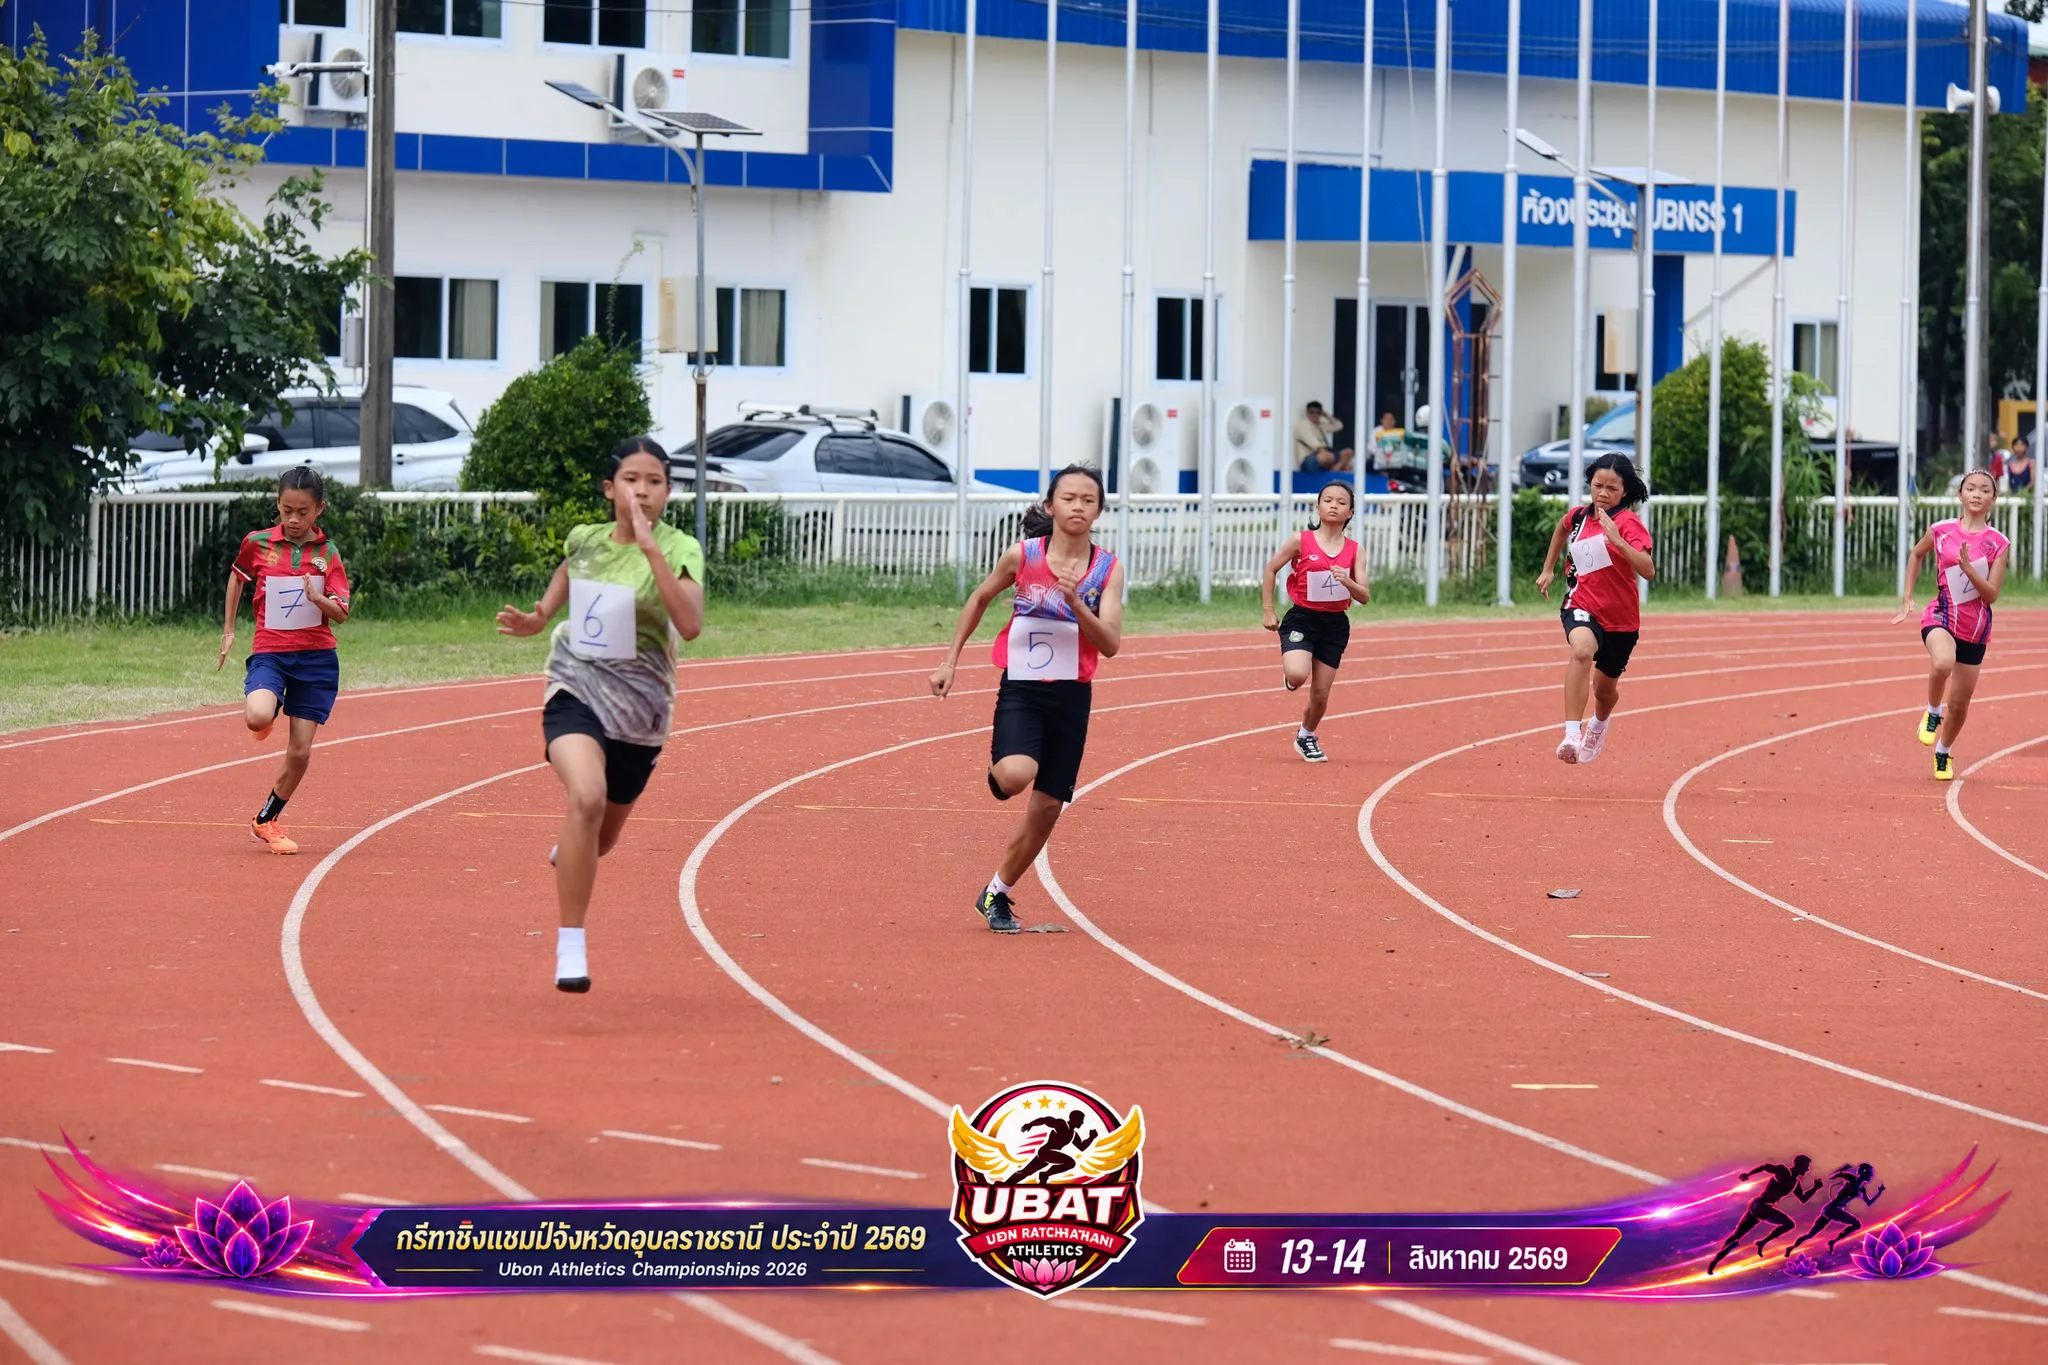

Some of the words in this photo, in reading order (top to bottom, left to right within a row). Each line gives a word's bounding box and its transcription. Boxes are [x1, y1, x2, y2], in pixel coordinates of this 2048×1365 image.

[1732, 203, 1743, 234] 1
[1581, 542, 1594, 569] 3
[1321, 574, 1341, 596] 4
[1959, 571, 1976, 594] 2
[279, 588, 305, 618] 7
[583, 593, 604, 639] 6
[1027, 632, 1054, 670] 5
